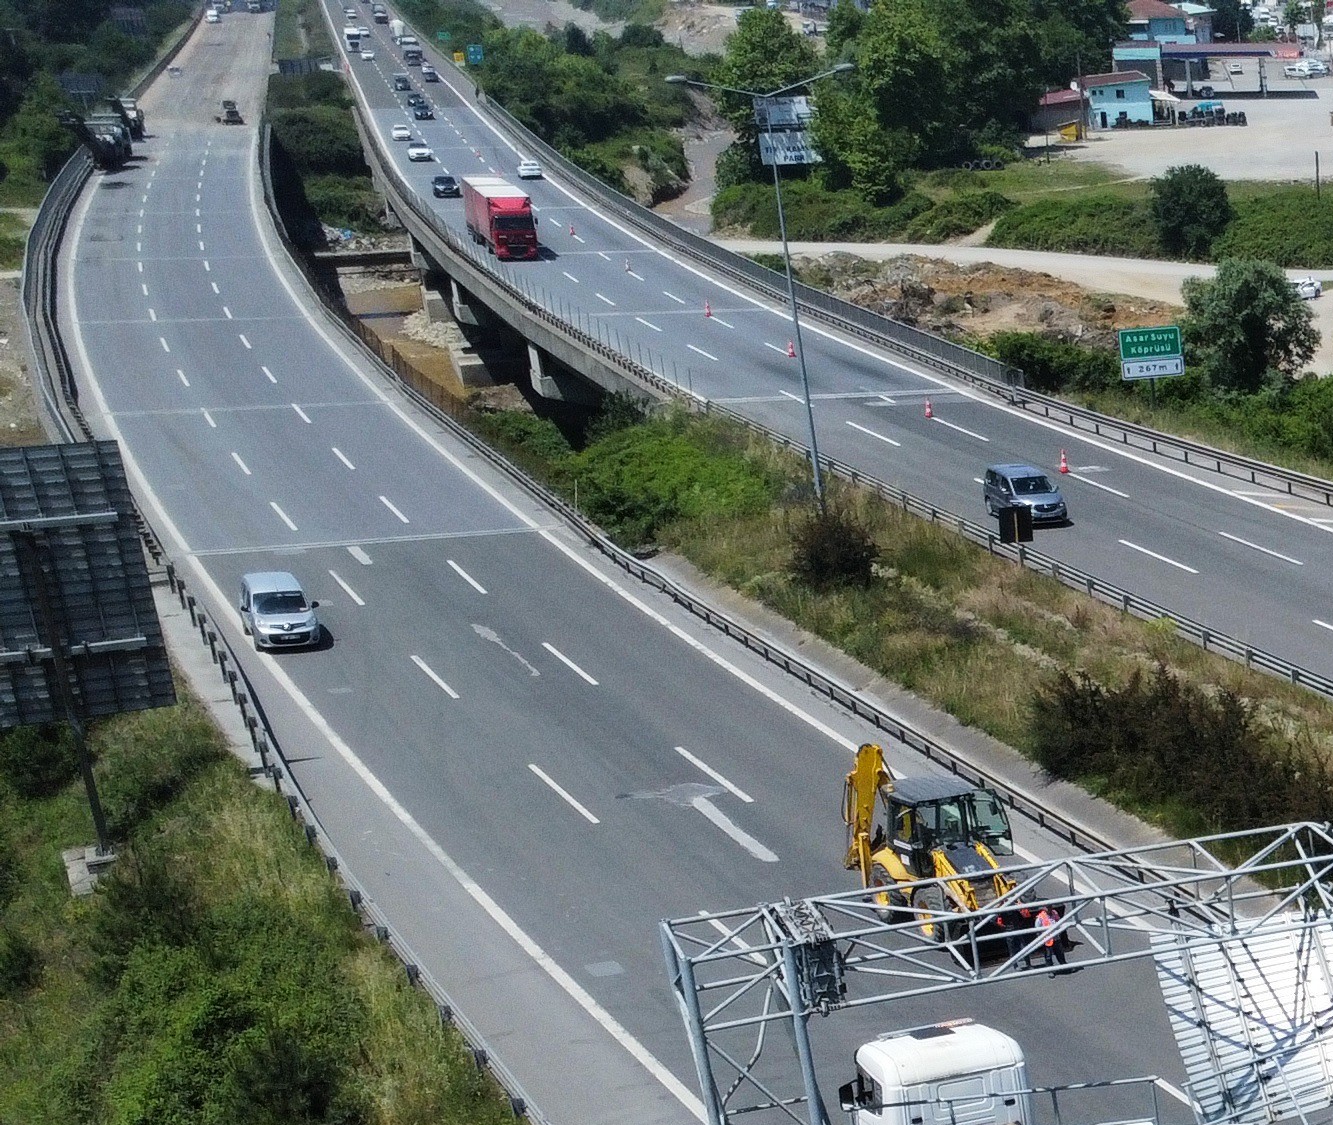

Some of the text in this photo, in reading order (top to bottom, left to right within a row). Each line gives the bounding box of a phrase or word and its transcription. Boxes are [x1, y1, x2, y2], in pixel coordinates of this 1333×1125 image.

[1125, 332, 1175, 343] Asar Suyu
[1130, 343, 1171, 354] Köprüsü
